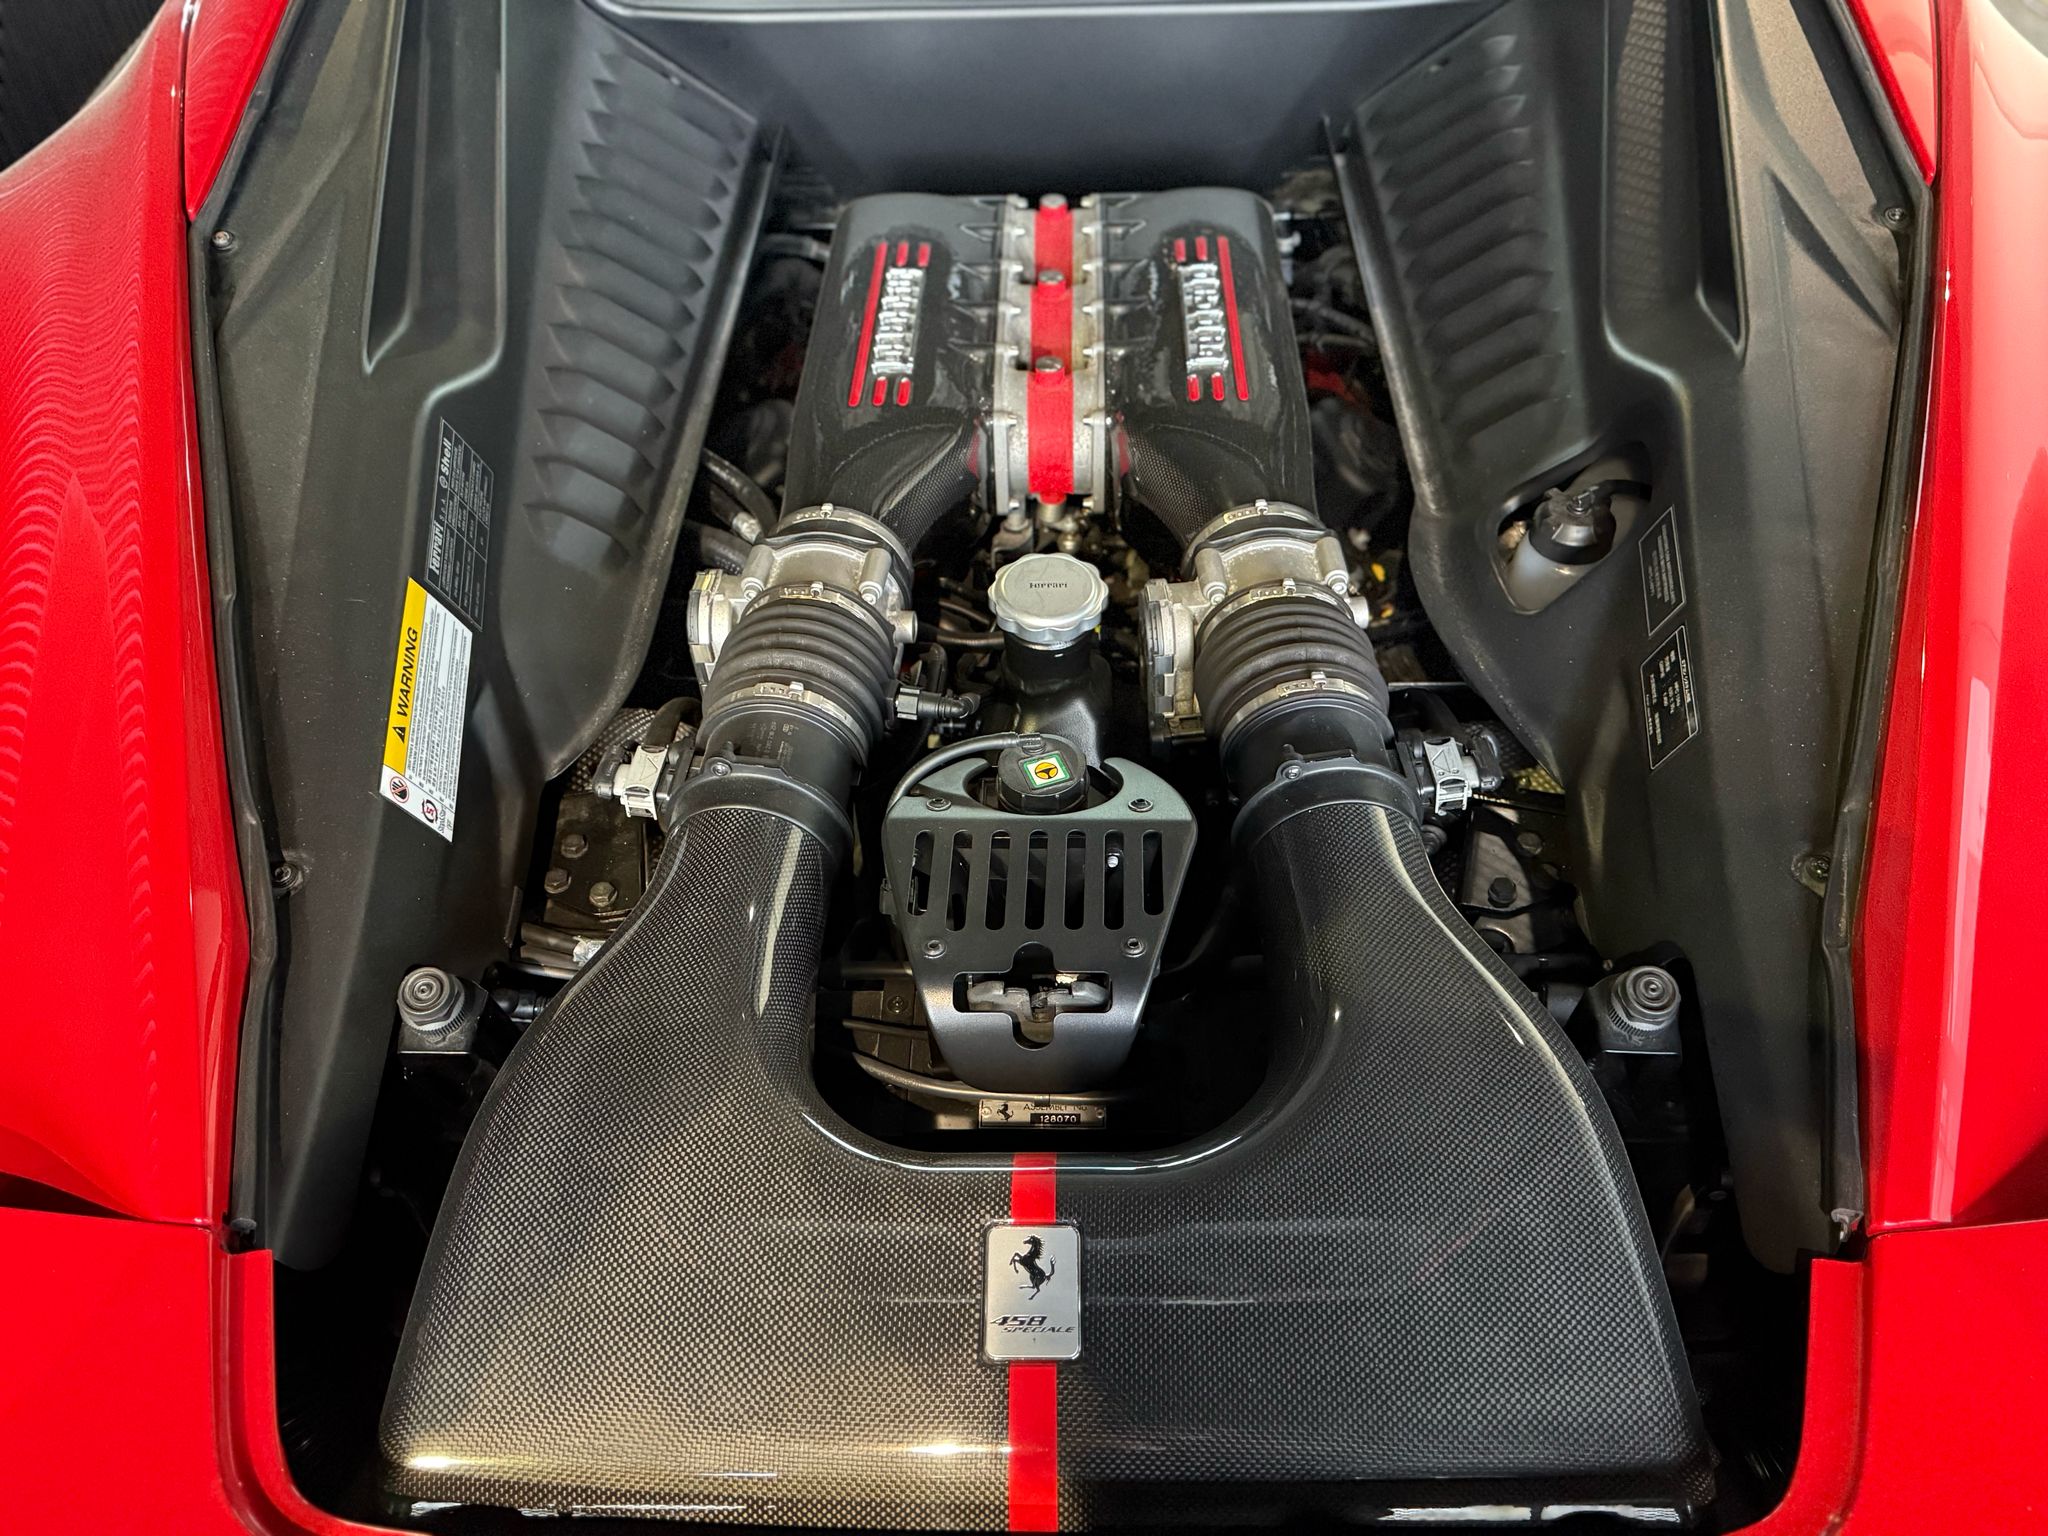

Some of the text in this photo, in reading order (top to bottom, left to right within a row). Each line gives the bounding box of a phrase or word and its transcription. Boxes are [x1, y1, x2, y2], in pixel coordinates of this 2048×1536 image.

[440, 437, 453, 477] Shell
[397, 626, 418, 718] WARNING
[1040, 1115, 1077, 1123] 128070
[990, 1315, 1048, 1326] 458
